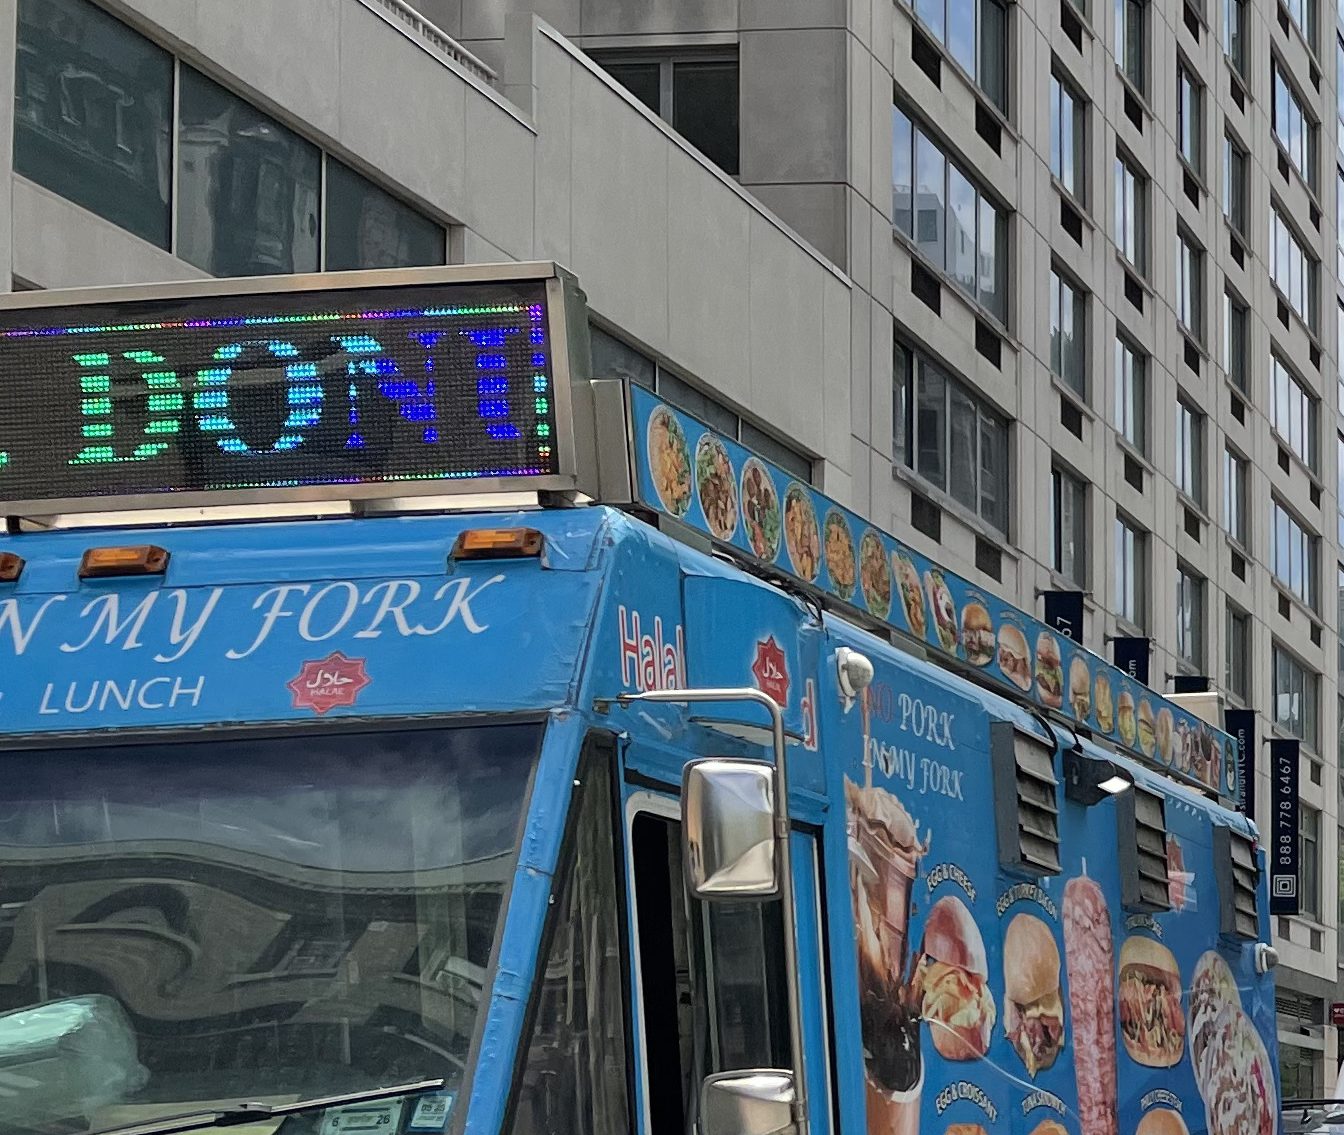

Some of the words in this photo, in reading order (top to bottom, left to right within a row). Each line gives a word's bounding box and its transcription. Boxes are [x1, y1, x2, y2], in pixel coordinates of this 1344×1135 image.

[60, 587, 224, 663] MY
[225, 574, 506, 660] FORK
[618, 604, 688, 707] Halal
[38, 675, 205, 715] LUNCH
[899, 693, 955, 750] PORK
[919, 758, 964, 802] FORK
[927, 864, 942, 893] EGG
[376, 1115, 391, 1125] 26
[936, 1086, 952, 1115] EGG
